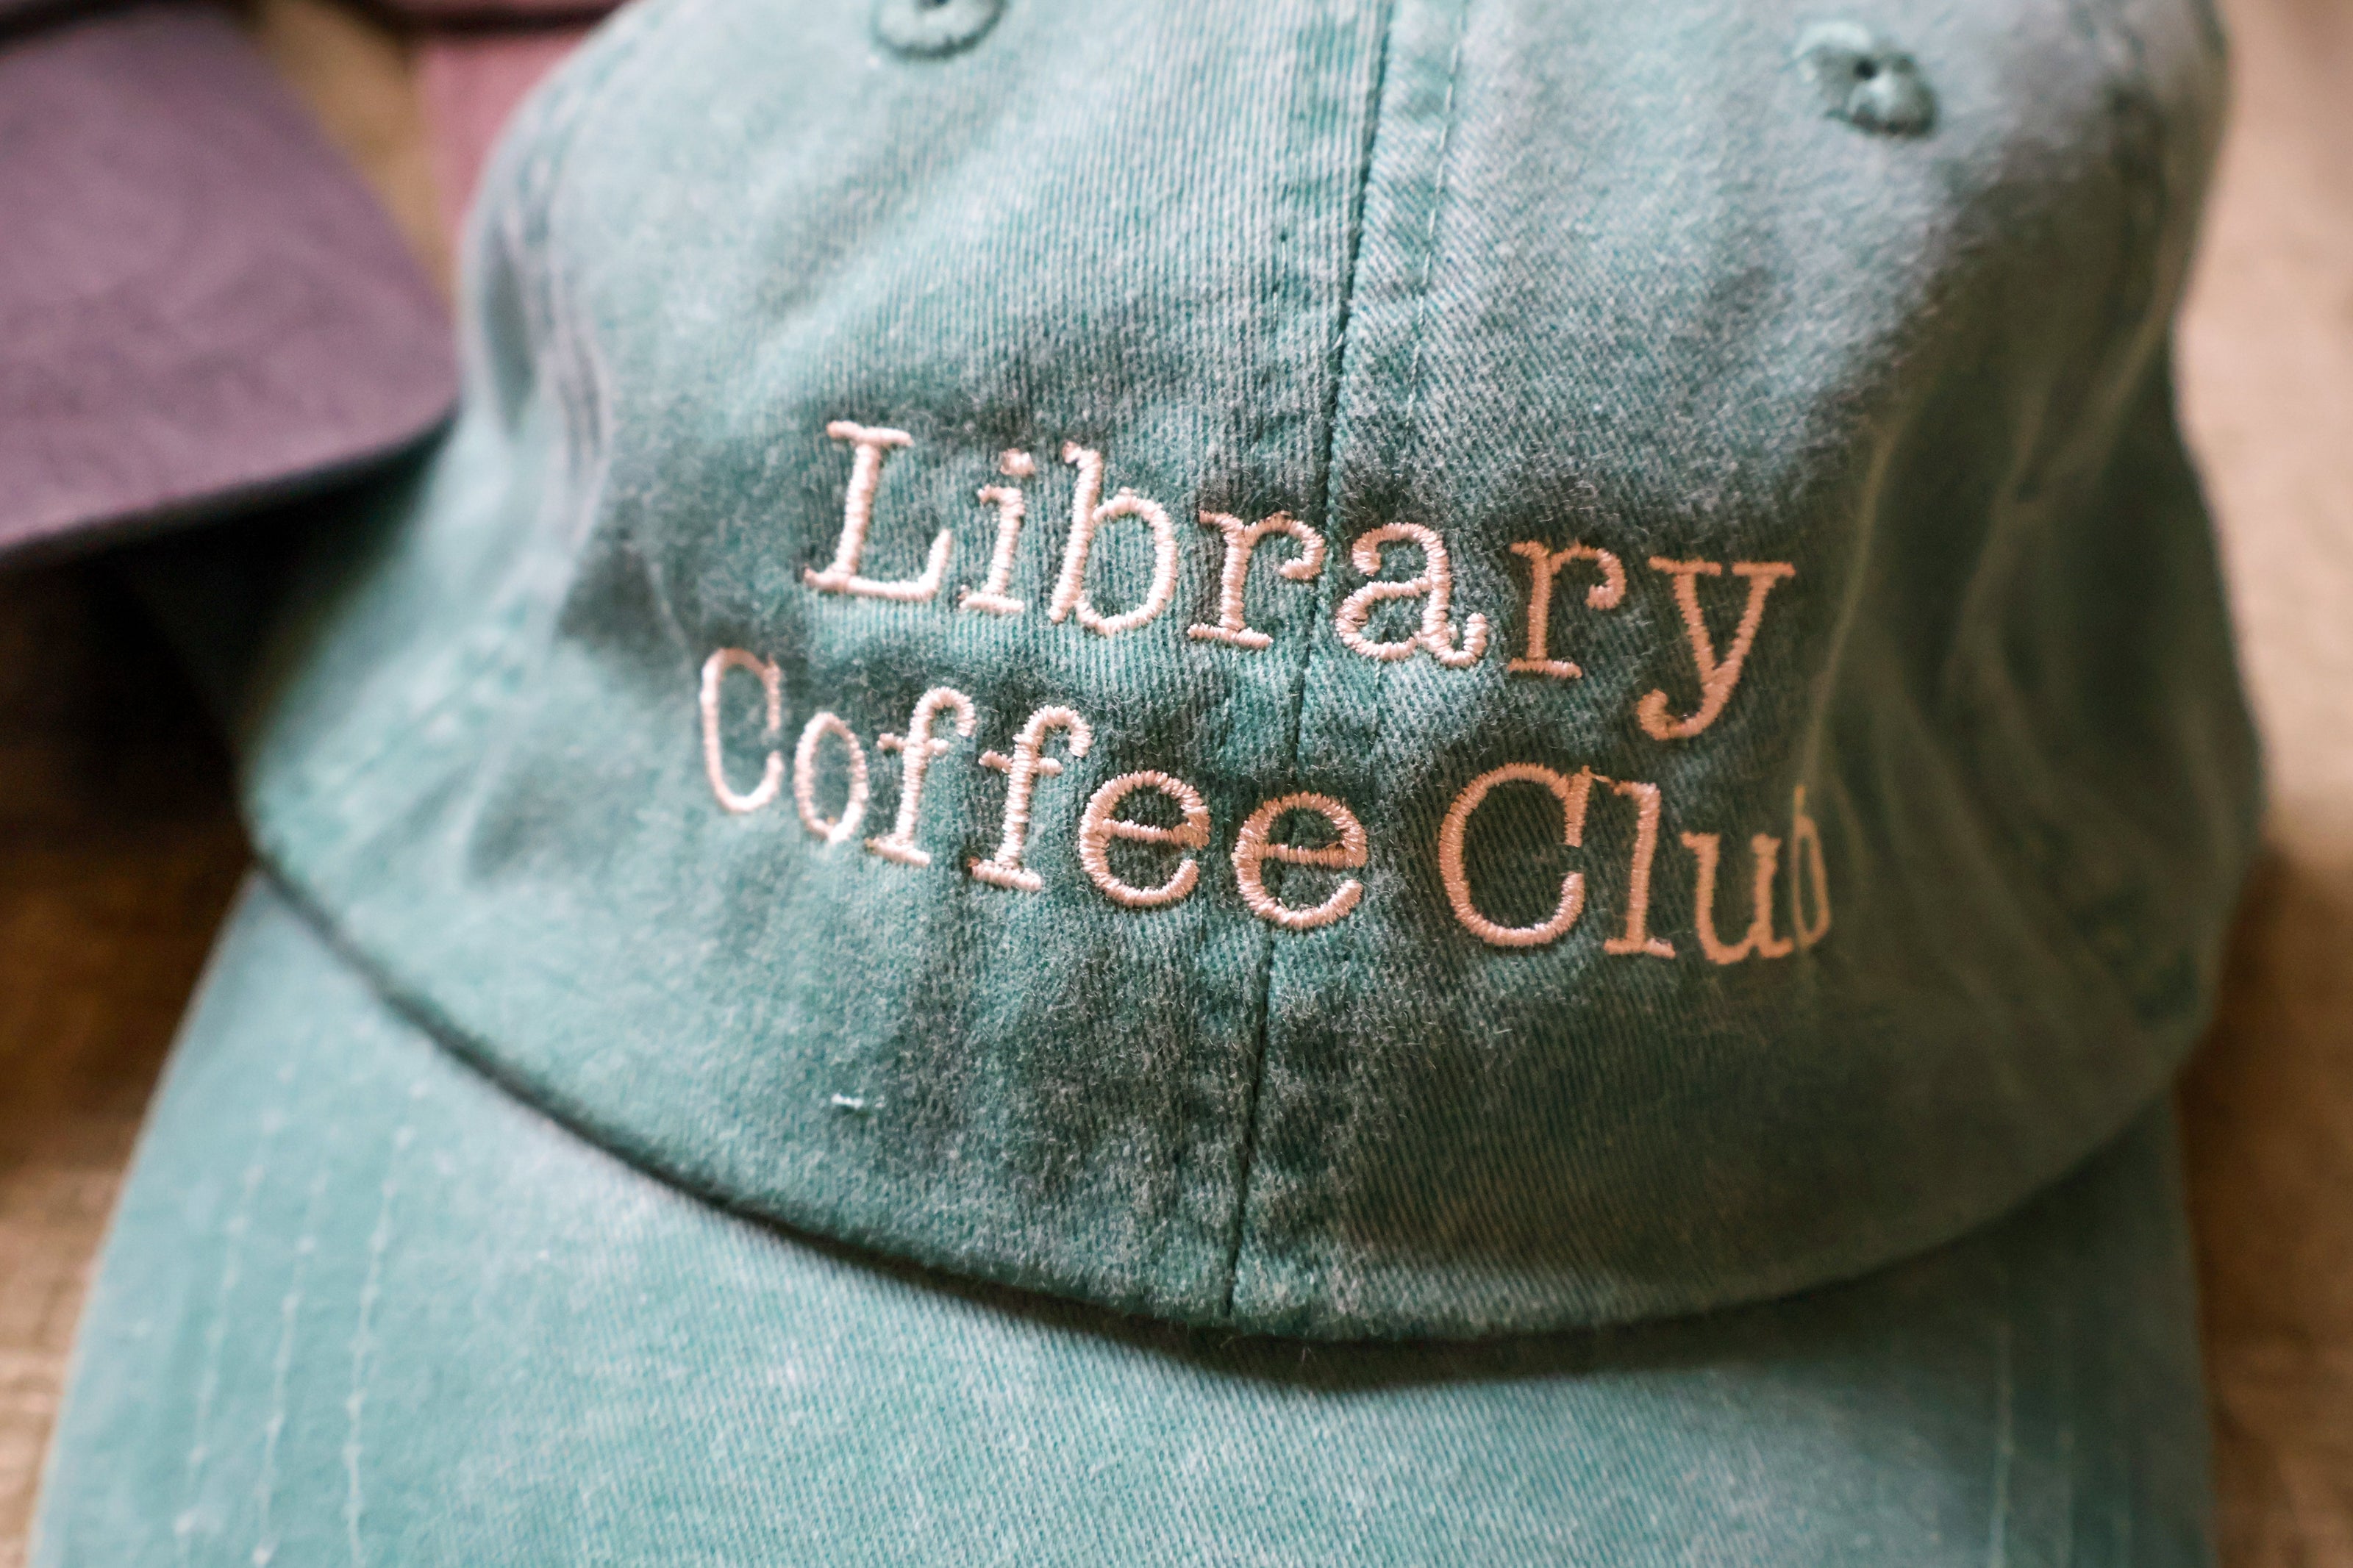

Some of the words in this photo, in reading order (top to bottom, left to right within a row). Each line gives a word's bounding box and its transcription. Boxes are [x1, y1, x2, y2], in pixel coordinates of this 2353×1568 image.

[804, 419, 1796, 740] Library
[700, 647, 1368, 928] Coffee
[1438, 764, 1831, 964] Club
